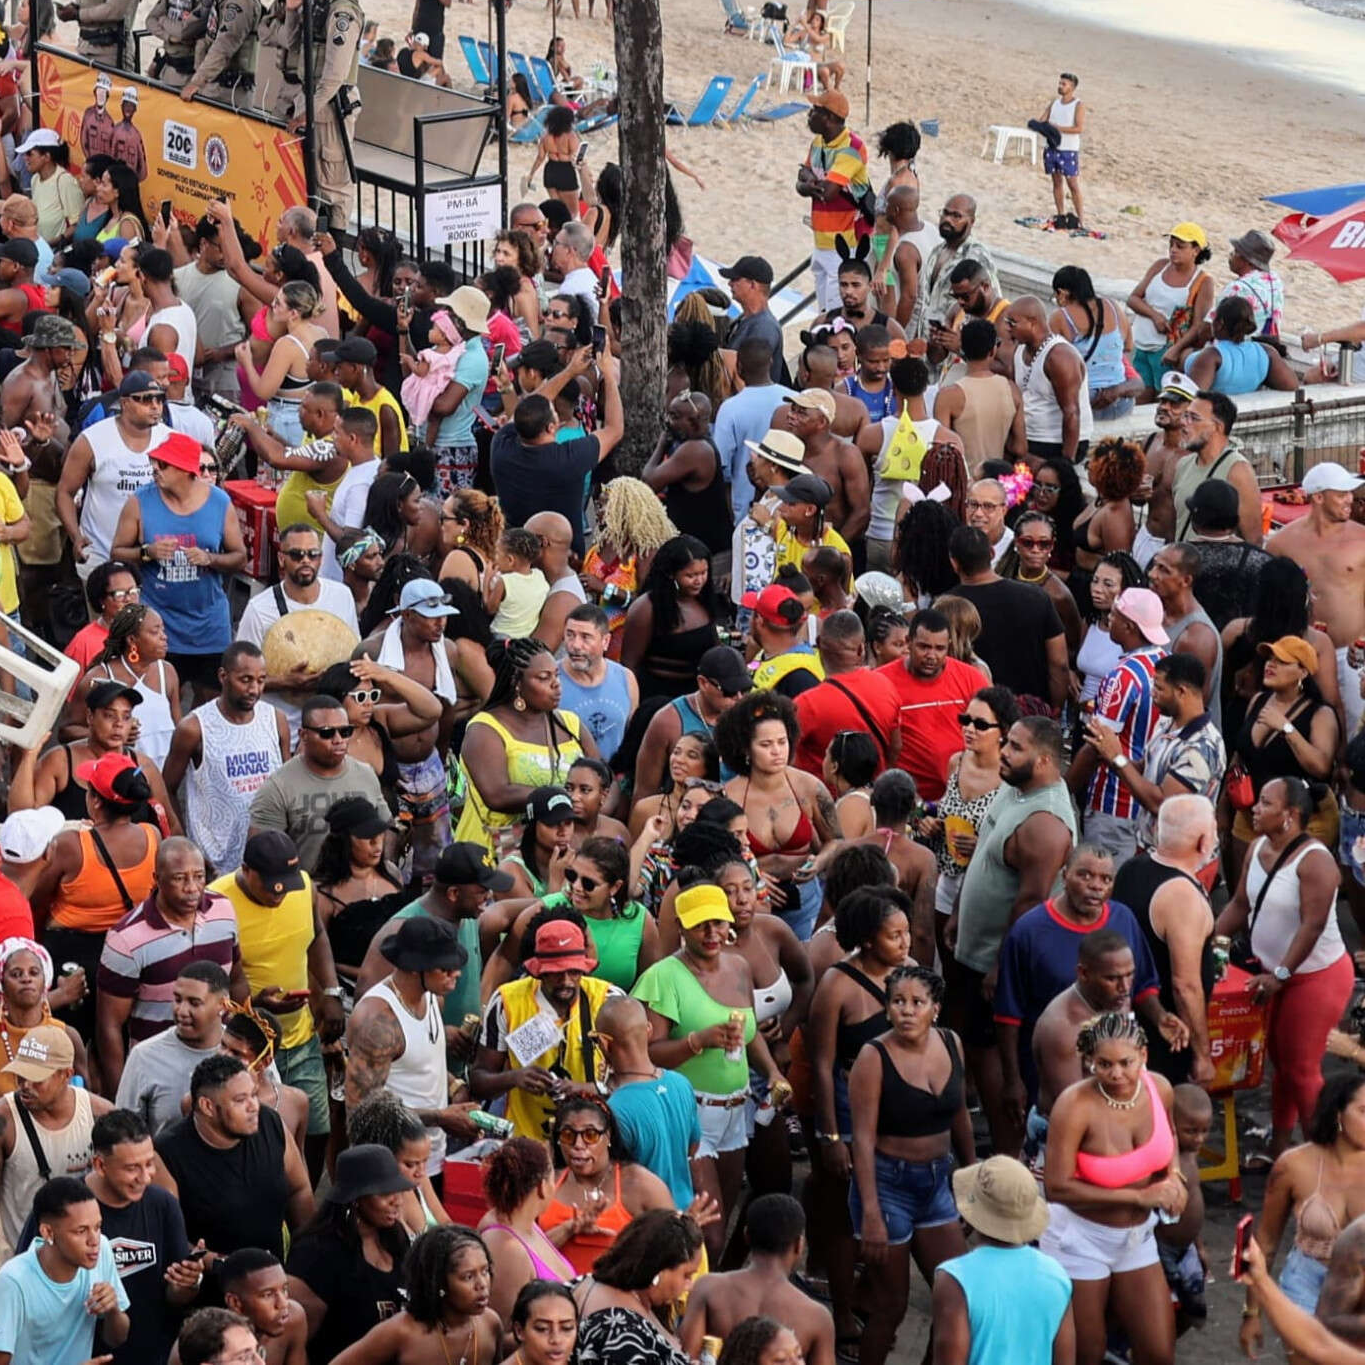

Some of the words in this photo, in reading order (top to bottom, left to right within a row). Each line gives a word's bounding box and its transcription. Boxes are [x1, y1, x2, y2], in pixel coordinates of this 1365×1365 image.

[446, 197, 480, 210] PM-BA
[226, 750, 269, 766] MUQUI
[226, 763, 270, 778] RANAS
